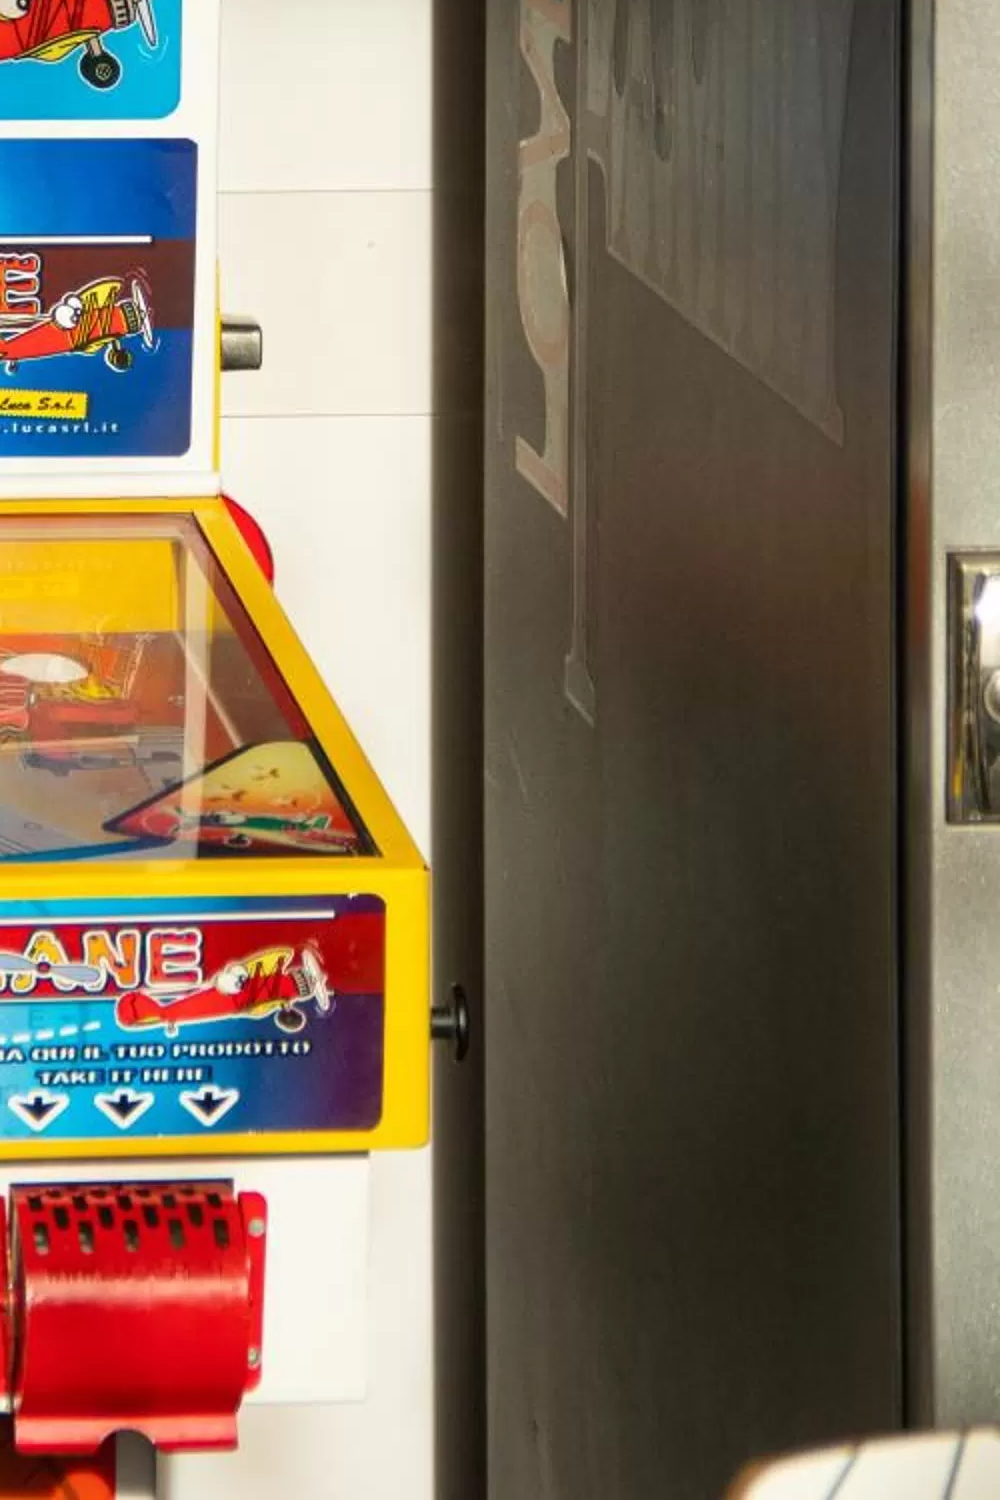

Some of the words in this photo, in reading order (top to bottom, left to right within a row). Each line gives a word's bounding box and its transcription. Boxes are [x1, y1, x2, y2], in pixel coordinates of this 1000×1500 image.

[31, 1046, 76, 1062] QUI
[83, 1046, 107, 1061] IL
[115, 1044, 165, 1060] TUO
[172, 1040, 312, 1059] PRODOTTO
[39, 1069, 99, 1086] TAKE
[111, 1068, 135, 1083] IT
[142, 1067, 204, 1084] HERE
